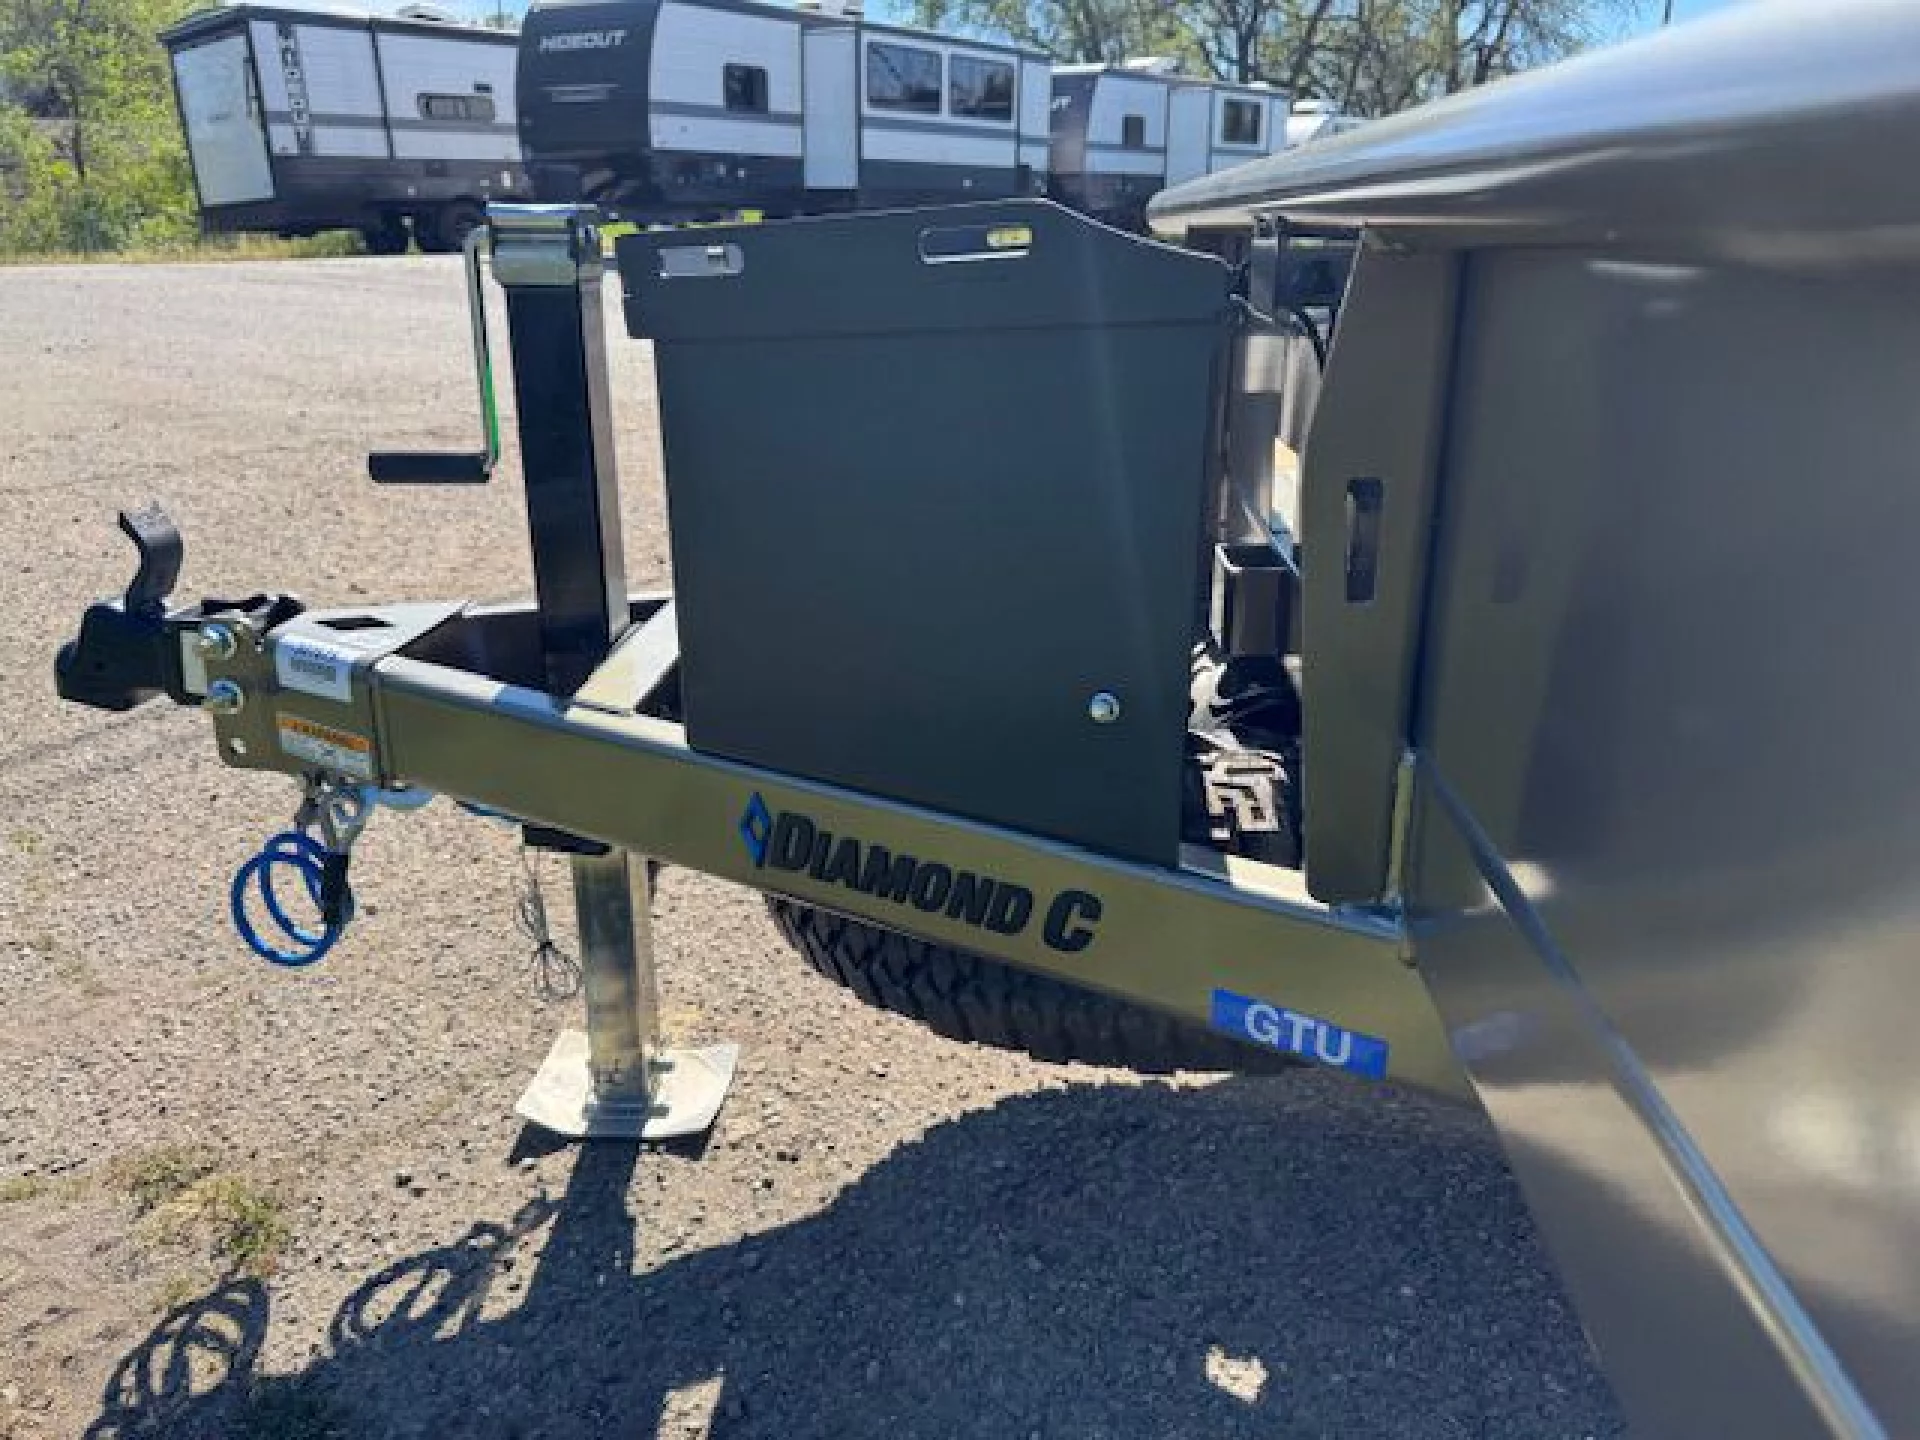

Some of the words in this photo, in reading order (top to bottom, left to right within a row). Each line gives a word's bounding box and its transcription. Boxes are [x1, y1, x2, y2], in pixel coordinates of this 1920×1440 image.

[540, 29, 627, 53] HIDEOUT
[769, 811, 1033, 935] DIAMOND
[1043, 889, 1102, 952] C
[1245, 1003, 1351, 1066] GTU
